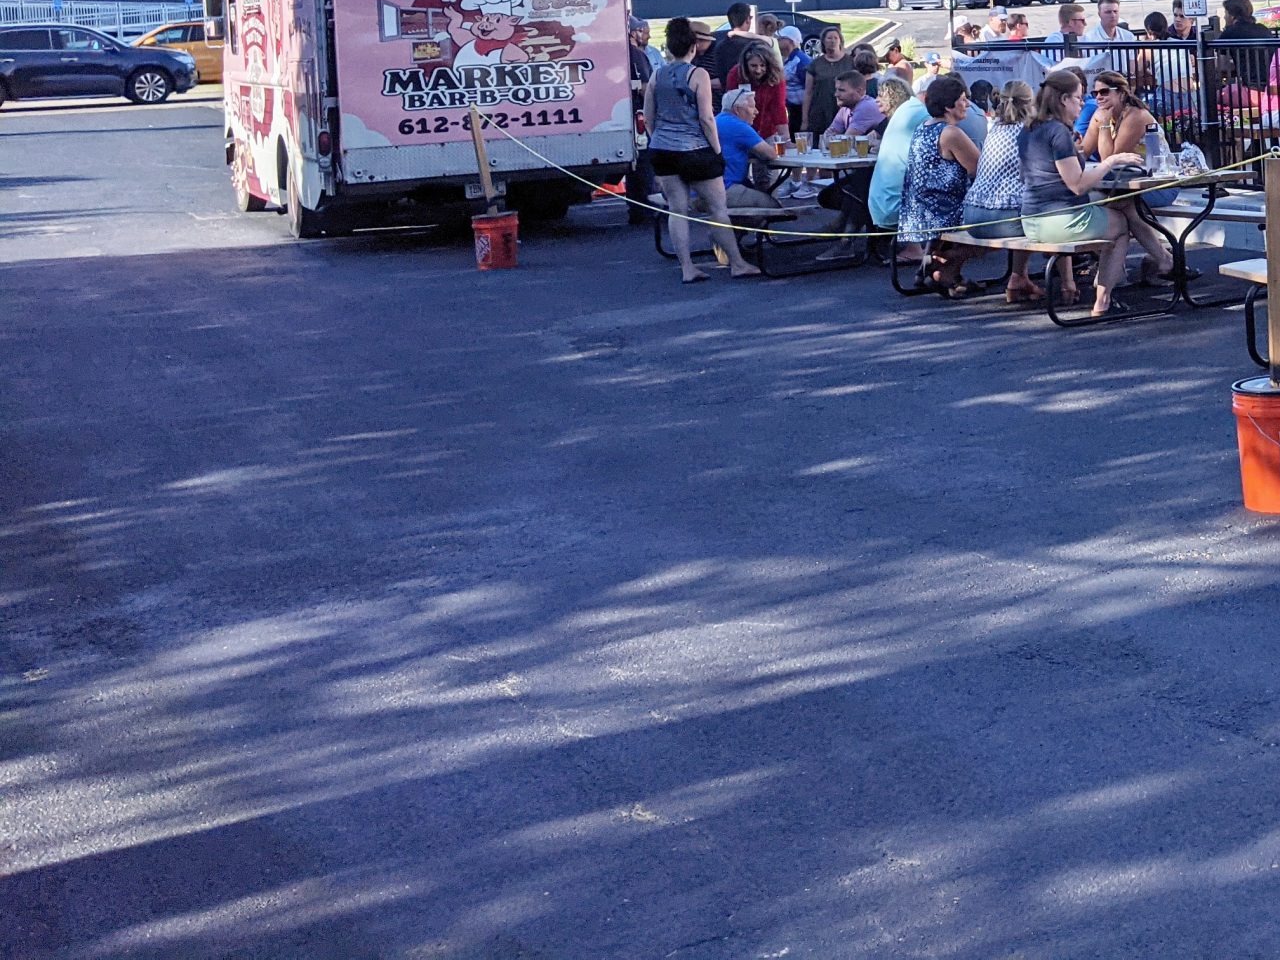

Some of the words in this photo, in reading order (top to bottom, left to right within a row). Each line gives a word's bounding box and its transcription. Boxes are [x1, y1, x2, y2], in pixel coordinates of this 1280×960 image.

[1188, 0, 1201, 10] LANE
[383, 59, 594, 95] MARKET
[403, 85, 574, 111] BAR-B-QUE
